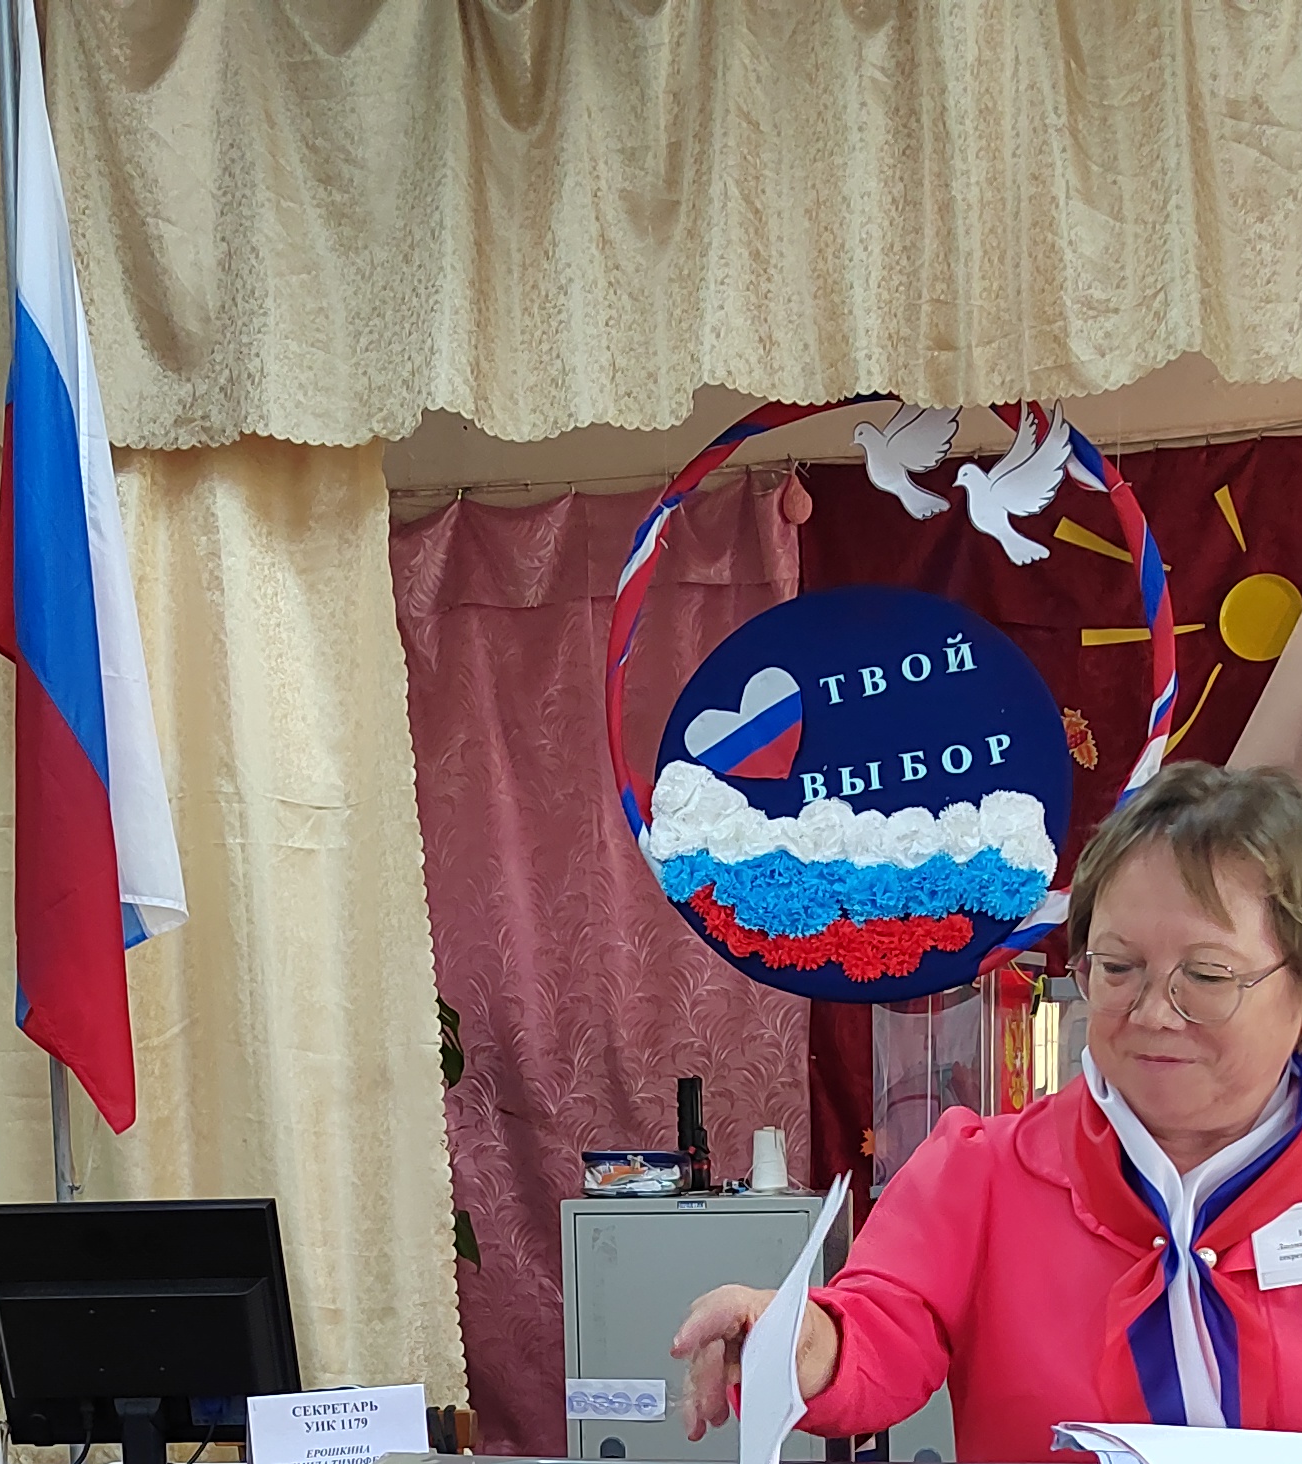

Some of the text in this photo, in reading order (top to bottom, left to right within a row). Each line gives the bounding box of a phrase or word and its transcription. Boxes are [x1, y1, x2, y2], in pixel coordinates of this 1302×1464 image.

[819, 632, 977, 705] ТВОЙ
[799, 734, 1011, 804] ВЫБОР
[291, 1400, 379, 1418] СЕКРЕТАРЬ
[304, 1417, 368, 1434] УИК 1179
[306, 1445, 371, 1459] ЕРОШКИНА
